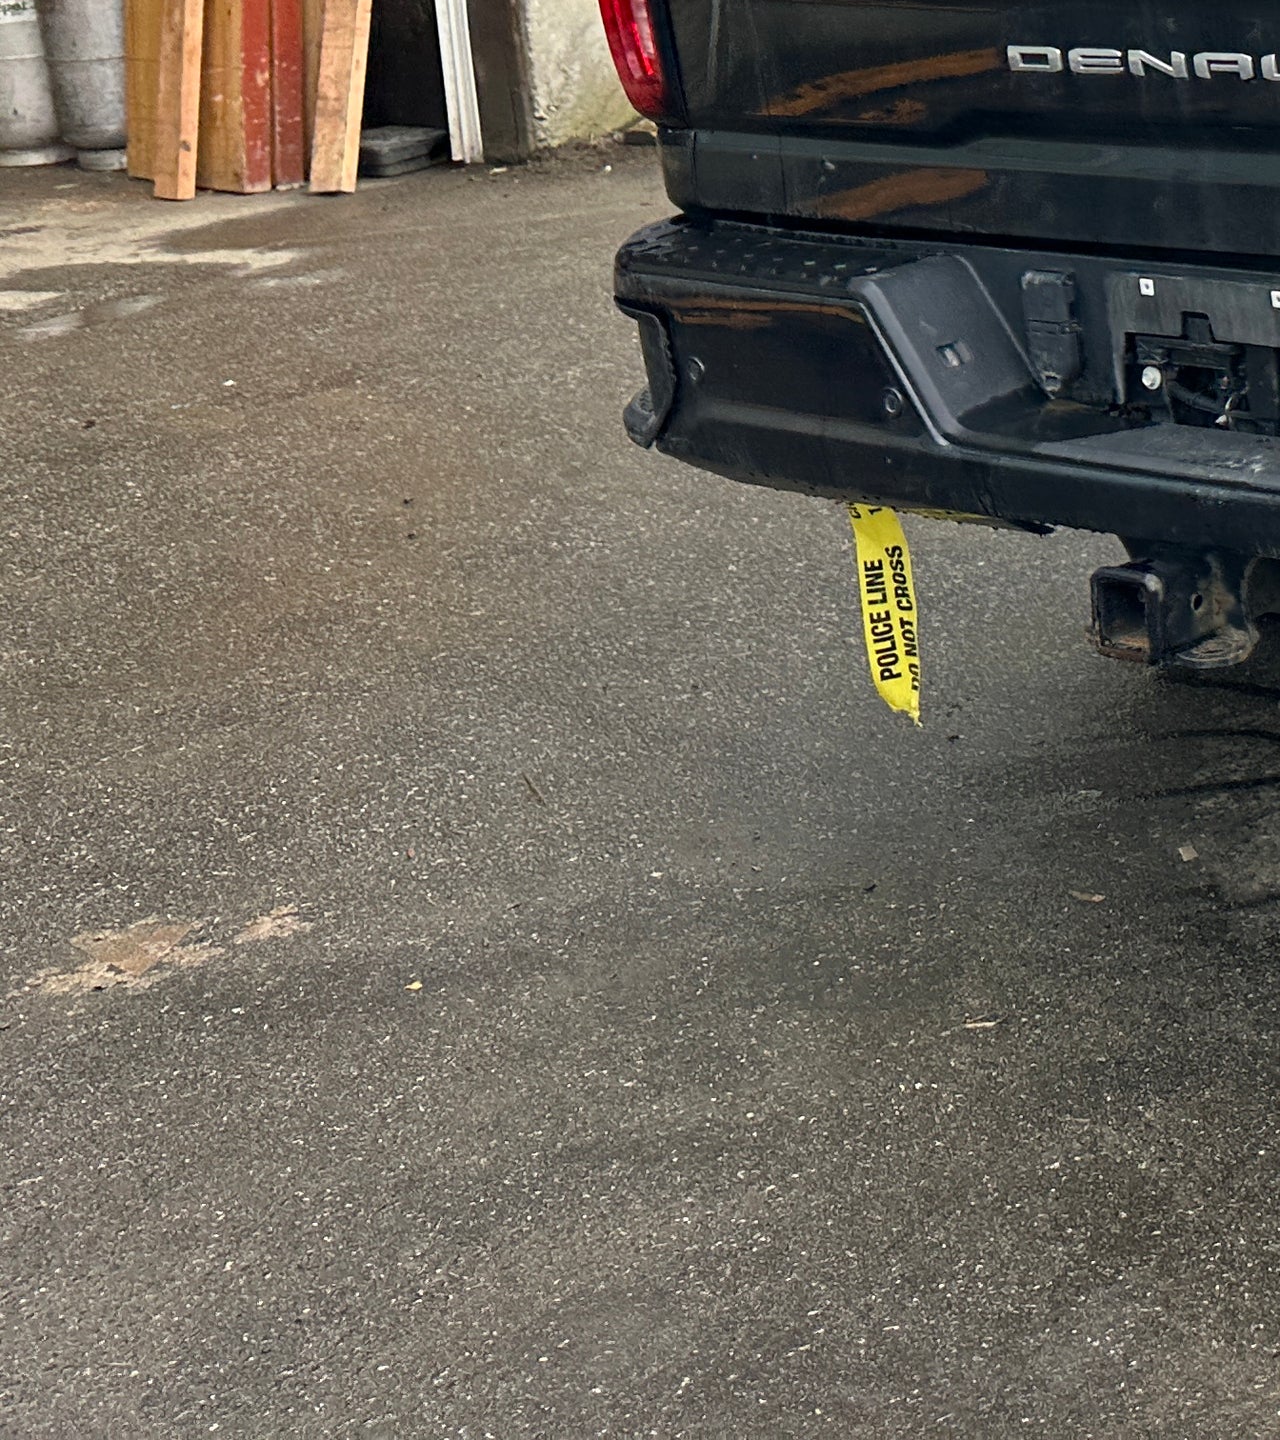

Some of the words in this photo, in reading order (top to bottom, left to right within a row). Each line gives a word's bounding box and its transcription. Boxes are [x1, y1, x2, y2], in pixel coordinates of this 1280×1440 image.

[864, 558, 888, 606] LINE
[884, 544, 914, 611] CROSS
[870, 610, 902, 681] POLICE
[899, 617, 918, 657] NOT
